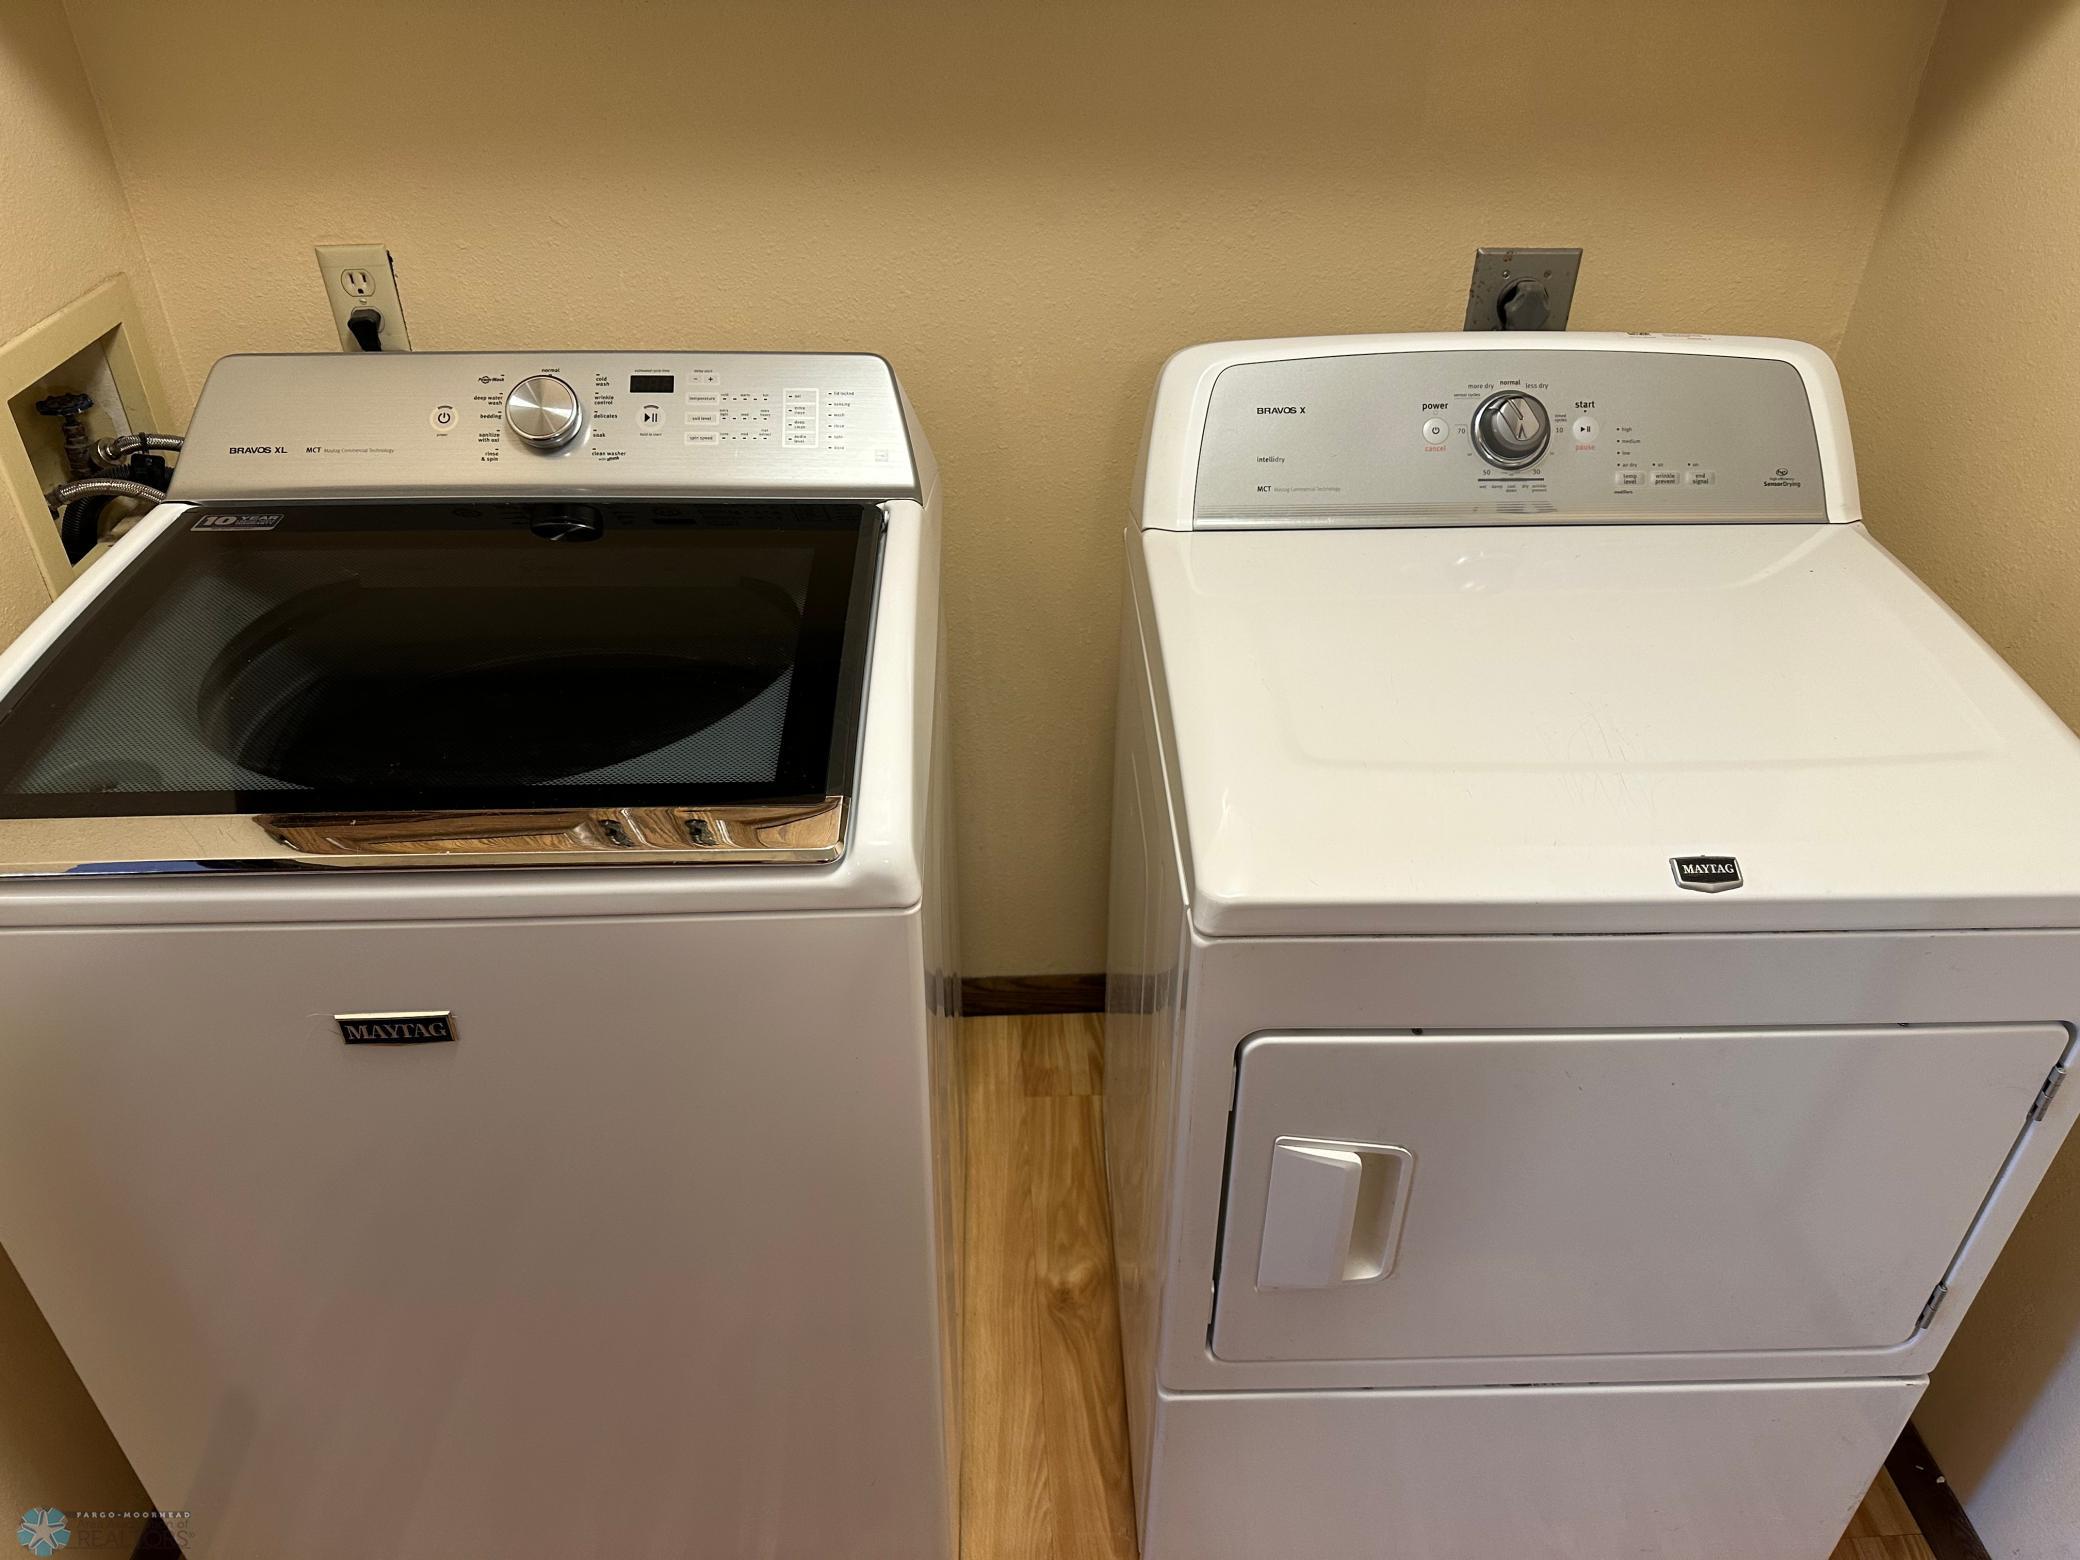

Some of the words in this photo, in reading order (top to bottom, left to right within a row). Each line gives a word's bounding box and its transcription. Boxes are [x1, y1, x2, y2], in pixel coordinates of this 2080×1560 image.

[1422, 403, 1448, 411] power
[203, 516, 237, 525] 10
[1682, 864, 1734, 873] MAYTAG
[344, 1022, 447, 1039] MAYTAG
